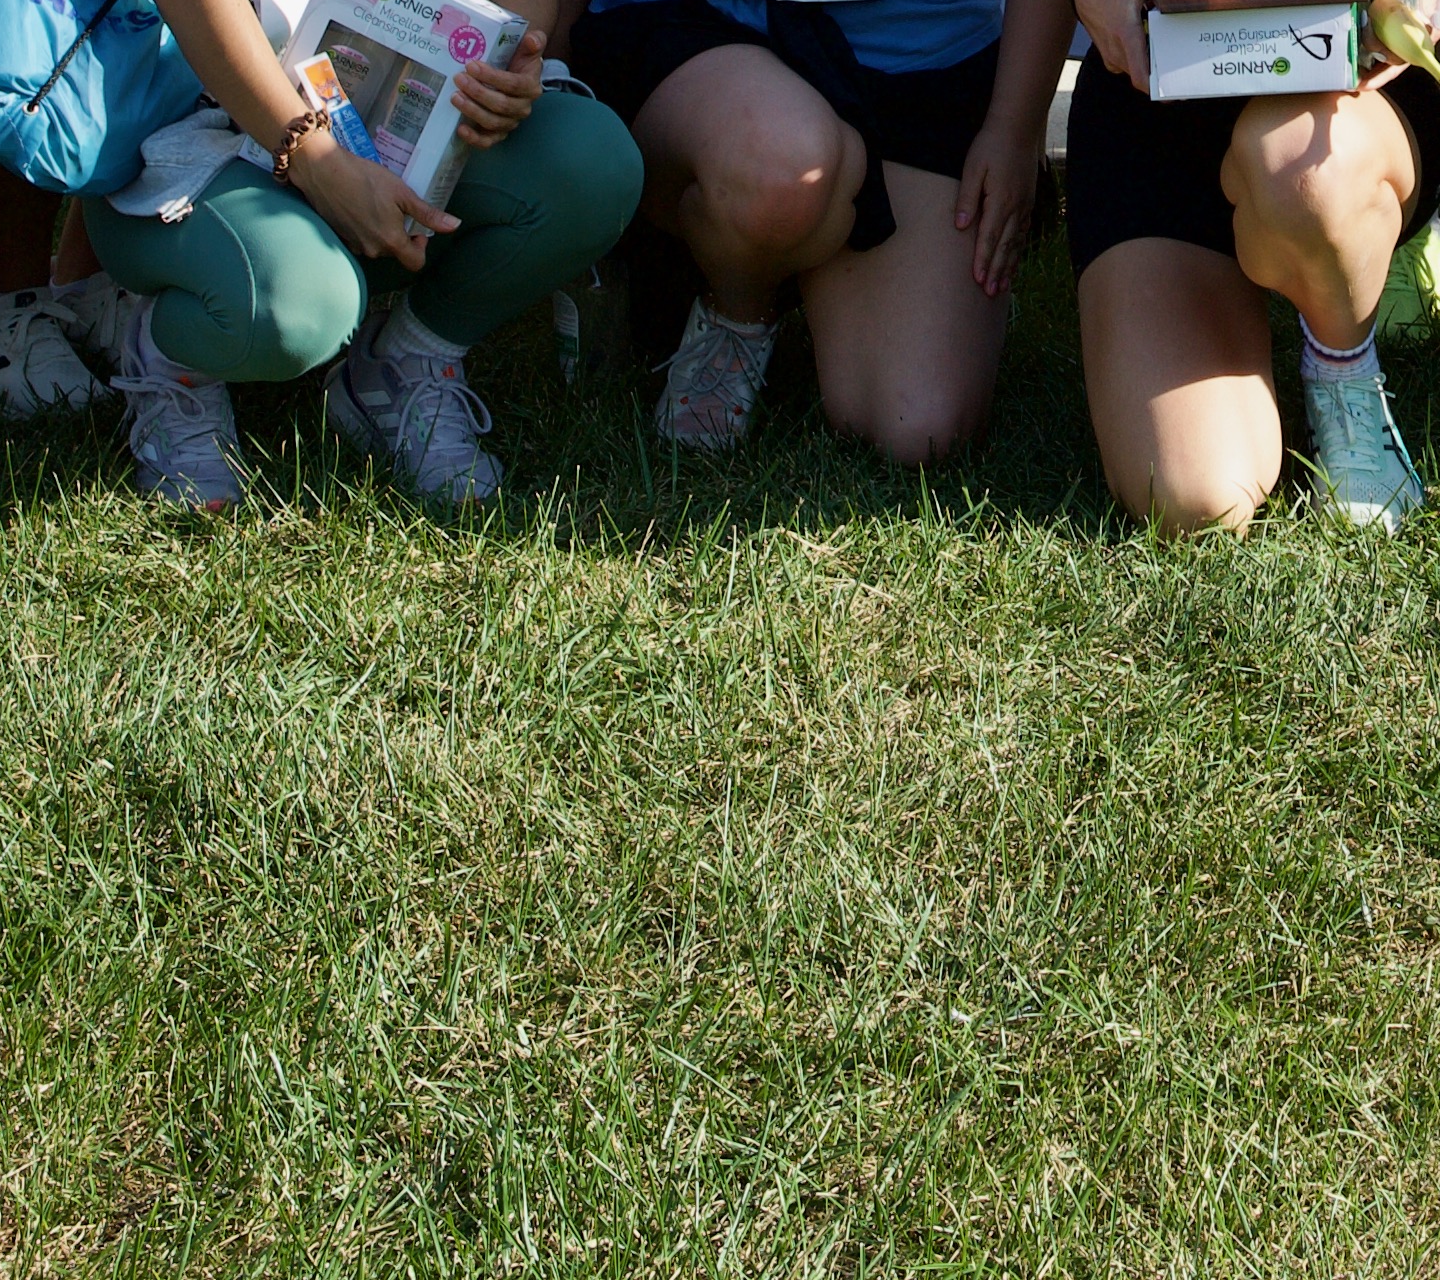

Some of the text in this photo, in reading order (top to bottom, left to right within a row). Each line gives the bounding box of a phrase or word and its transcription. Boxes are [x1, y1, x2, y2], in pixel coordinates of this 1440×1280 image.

[379, 4, 424, 33] Micellar
[353, 5, 407, 42] Cleansing
[408, 33, 442, 56] Water
[1199, 28, 1303, 42] Cleansing Water
[457, 37, 476, 55] #1
[1227, 41, 1277, 54] Micellar
[1212, 56, 1291, 76] GARNIER
